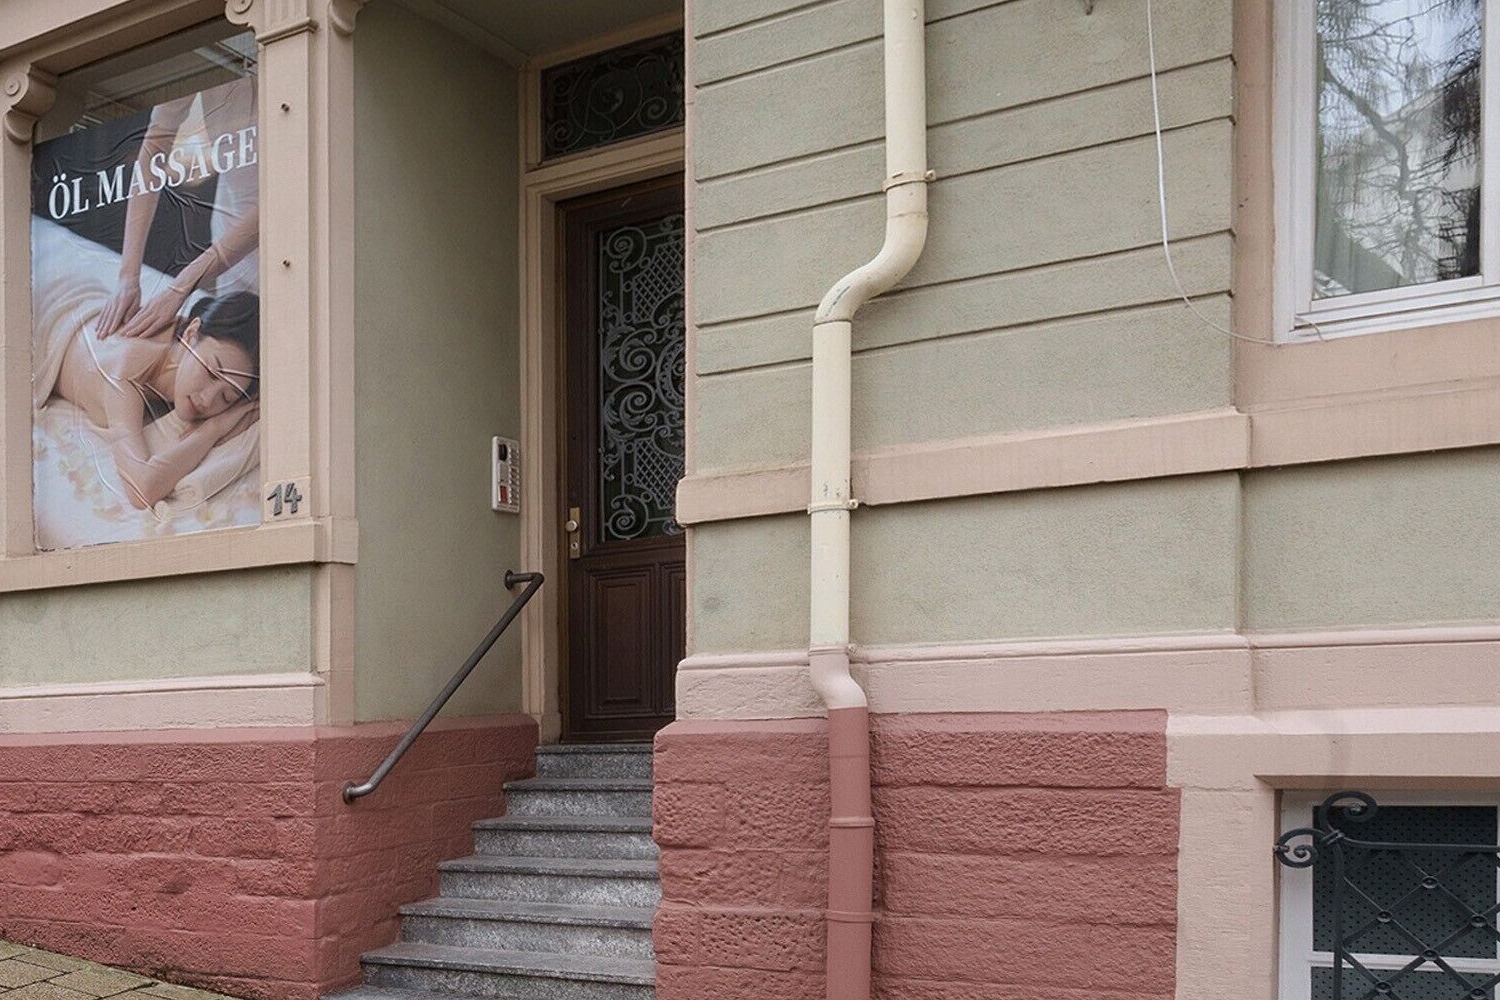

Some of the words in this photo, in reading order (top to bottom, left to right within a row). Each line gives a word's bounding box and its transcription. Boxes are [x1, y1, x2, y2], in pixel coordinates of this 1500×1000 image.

[49, 172, 90, 221] ÖL
[96, 125, 259, 209] MASSAGE
[266, 482, 303, 517] 14
